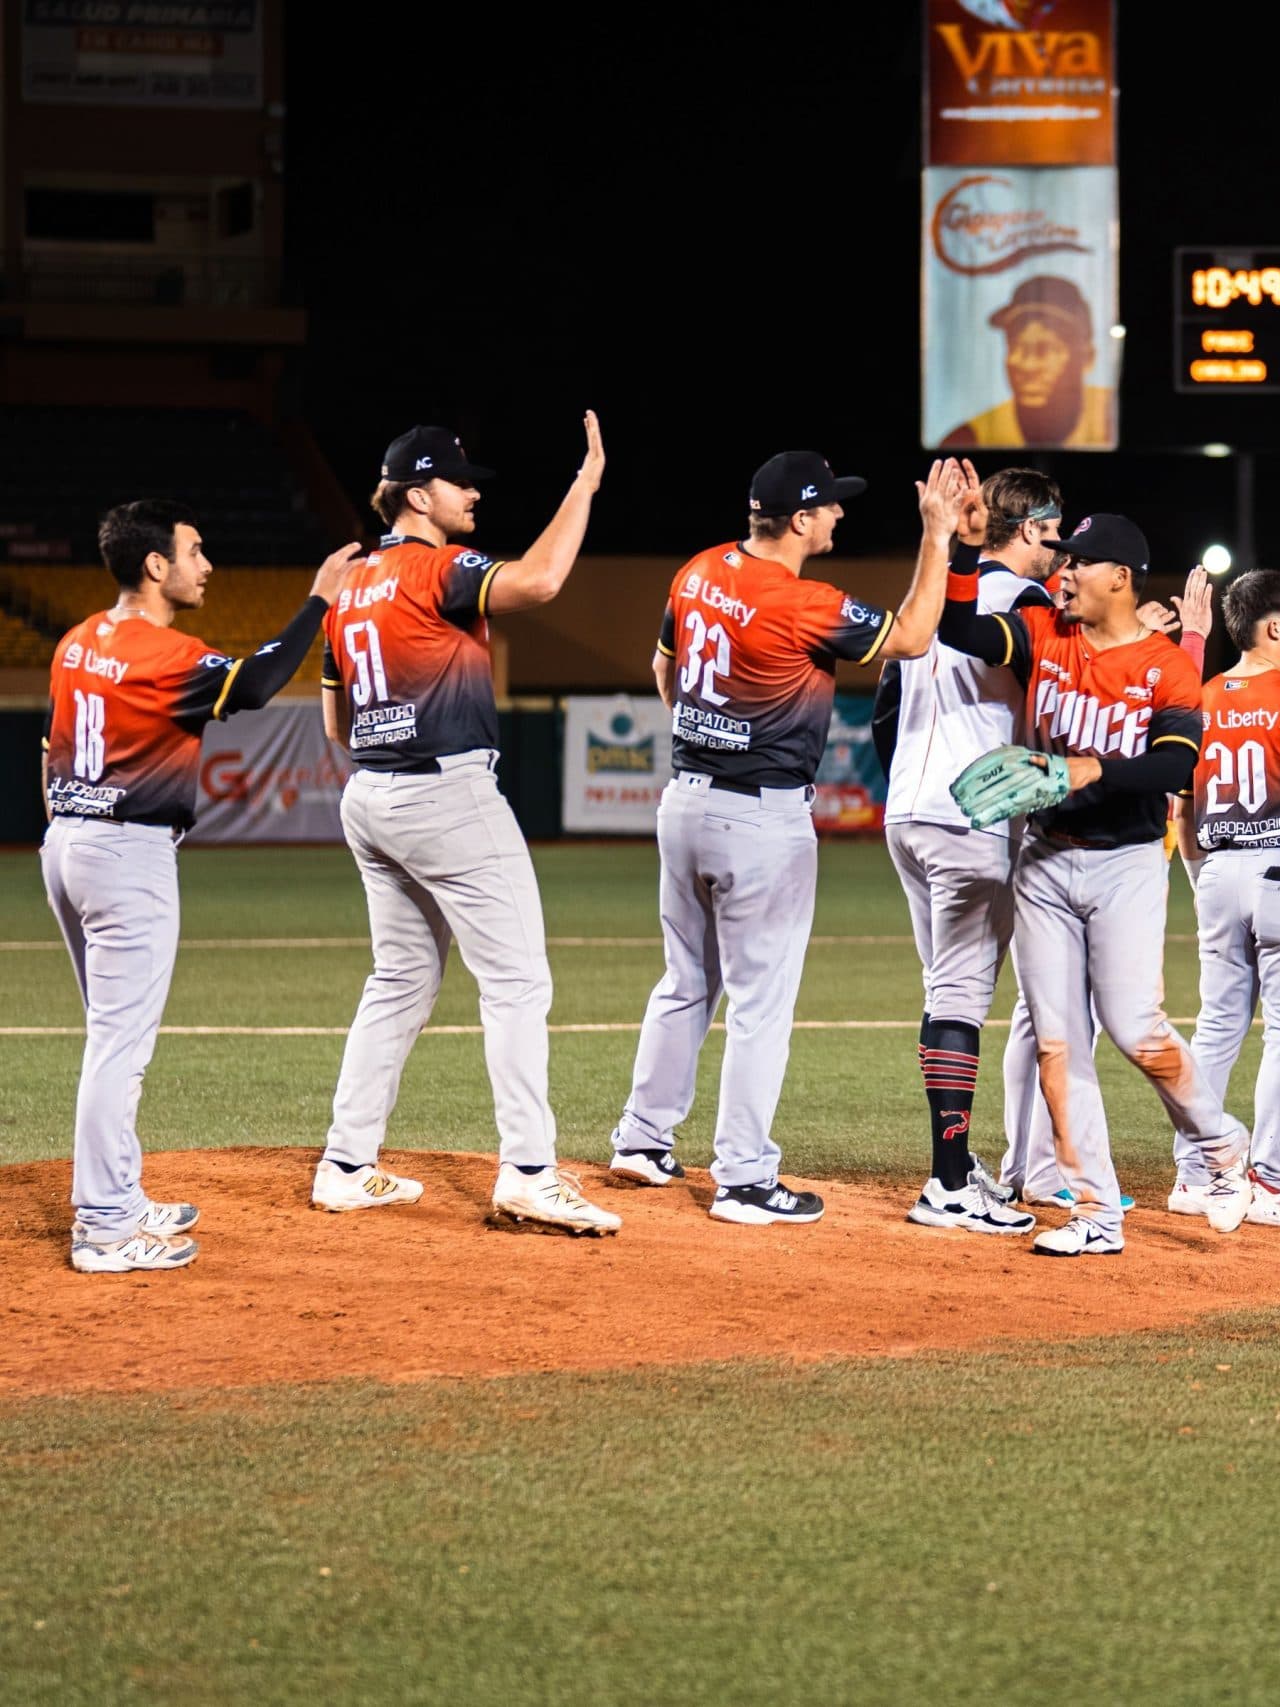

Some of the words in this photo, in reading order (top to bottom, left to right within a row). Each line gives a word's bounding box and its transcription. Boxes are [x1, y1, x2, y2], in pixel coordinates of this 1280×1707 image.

[344, 619, 389, 707] 51
[680, 610, 731, 707] 32
[74, 688, 106, 782] 18
[1216, 708, 1280, 731] Liberty
[1205, 739, 1268, 815] 20
